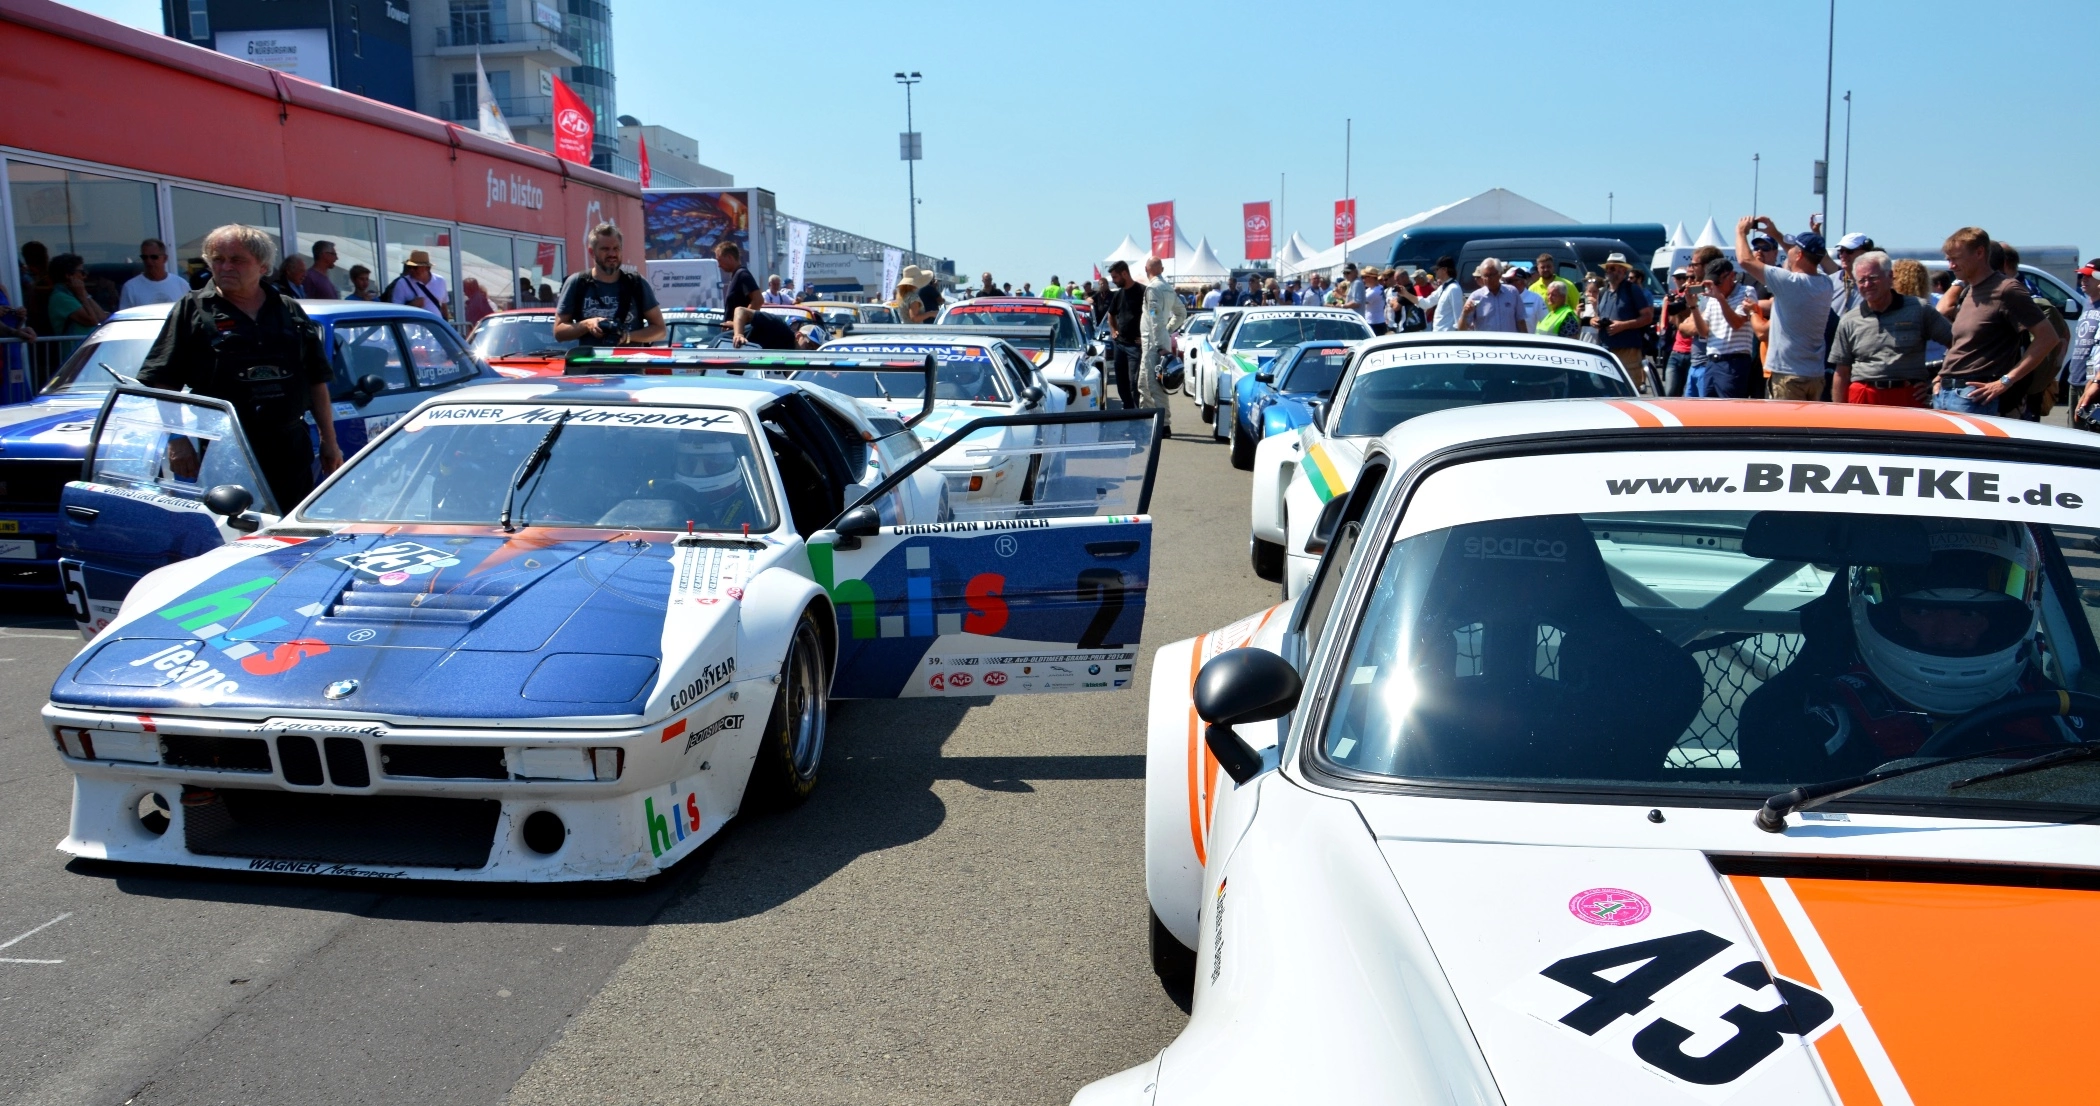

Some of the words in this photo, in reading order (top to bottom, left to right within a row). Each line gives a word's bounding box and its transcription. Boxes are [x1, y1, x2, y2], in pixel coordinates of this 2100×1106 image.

[386, 1, 410, 24] Tower
[248, 41, 254, 55] 6
[487, 168, 506, 207] fan
[510, 174, 543, 209] bistro
[488, 315, 556, 326] PORSC
[950, 305, 1065, 315] SCHNITZER
[1299, 311, 1352, 321] ITALIA
[1392, 349, 1589, 367] Hahn-Sportwagen
[428, 408, 503, 420] WAGNER
[496, 407, 733, 428] Motorsport
[1605, 463, 2085, 509] www.BRATKE.de
[894, 523, 979, 536] CHRISTIAN
[984, 516, 1050, 531] DANNER
[341, 544, 452, 573] 25
[1463, 536, 1568, 560] sparco
[1077, 567, 1124, 650] 2
[129, 640, 239, 706] jeans
[951, 674, 972, 687] AvD
[986, 673, 1007, 686] AvD
[684, 715, 744, 755] jeanswear
[249, 859, 321, 874] WAGNER
[315, 863, 408, 879] Motorsport
[1539, 930, 1835, 1086] 43
